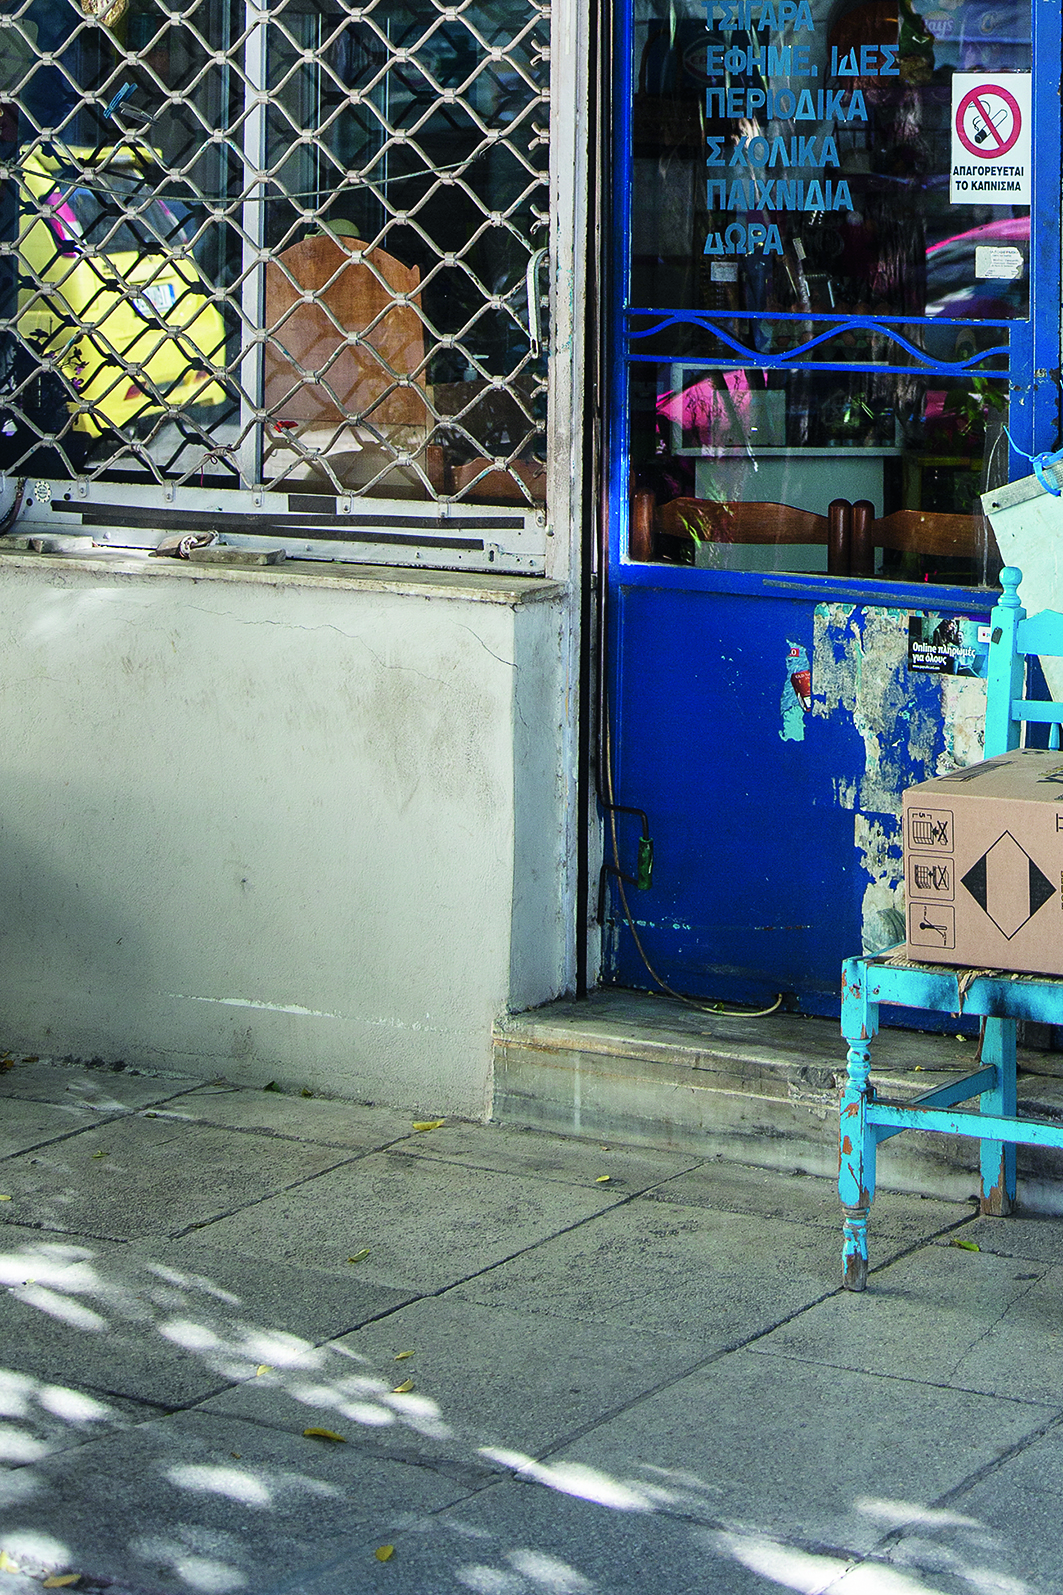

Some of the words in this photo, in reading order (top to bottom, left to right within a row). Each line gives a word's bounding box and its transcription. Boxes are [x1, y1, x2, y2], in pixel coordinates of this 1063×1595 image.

[700, 0, 815, 32] ΤΣΙΓΑΡΑ
[705, 87, 868, 121] ΠΕΡΙΟΔΙΚΑ
[706, 135, 840, 167] ΣΧΟΛΙΚΑ
[953, 165, 1025, 177] ΑΠΑΓΟΡΕΥΕΤΑΙ
[706, 178, 854, 211] ΠΑΙΧΝΙΔΙΑ
[955, 180, 969, 191] ΤΟ
[971, 181, 1021, 192] ΚΑΠΝΙΣΜΑ
[912, 642, 937, 654] Online
[937, 645, 976, 659] πληρωμές
[912, 653, 924, 665] για
[924, 653, 948, 666] όλους
